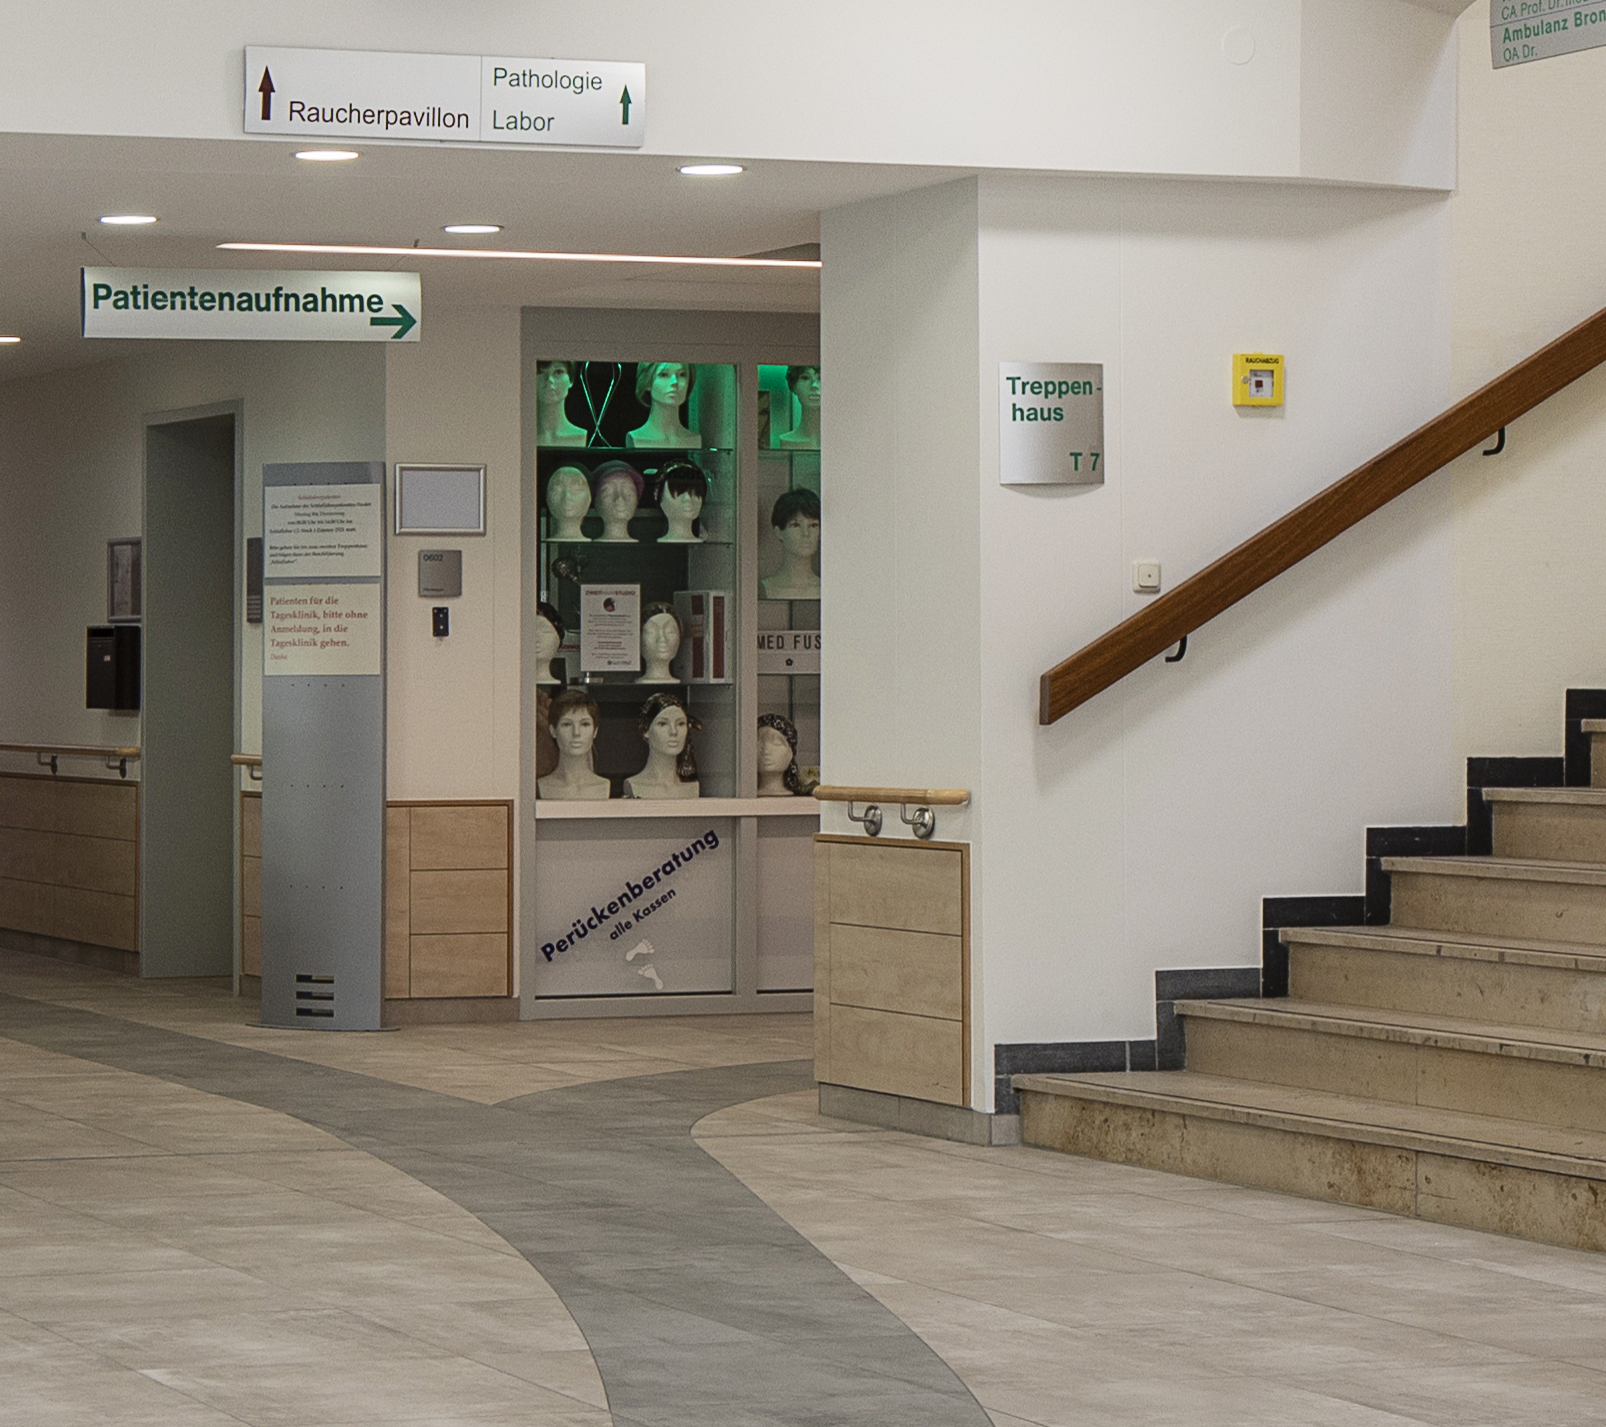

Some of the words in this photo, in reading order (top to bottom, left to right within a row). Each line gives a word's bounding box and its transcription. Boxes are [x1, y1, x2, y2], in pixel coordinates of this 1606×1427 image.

[1501, 6, 1518, 22] CA
[1520, 0, 1544, 16] Prof.
[1502, 18, 1569, 45] Ambulanz
[1503, 46, 1520, 63] OA
[1521, 42, 1538, 59] Dr.
[494, 67, 602, 94] Pathologie
[289, 101, 468, 130] Raucherpavillon
[493, 110, 554, 131] Labor
[93, 284, 383, 313] Patientenaufnahme
[1012, 403, 1064, 422] haus
[1070, 452, 1082, 471] T
[1090, 453, 1100, 471] 7
[270, 597, 307, 605] Patienten
[310, 596, 323, 604] für
[325, 596, 339, 604] die
[271, 610, 320, 620] Tagesklinik,
[323, 610, 342, 619] bitte
[345, 610, 368, 619] ohne
[271, 624, 320, 635] Anmeldung,
[323, 624, 332, 633] in
[334, 624, 348, 633] die
[271, 639, 317, 649] Tagesklinik
[320, 639, 350, 649] gehen.
[757, 635, 784, 649] MED
[541, 829, 720, 962] Perückenberatung
[610, 921, 633, 941] alle
[632, 888, 677, 923] Kassen
